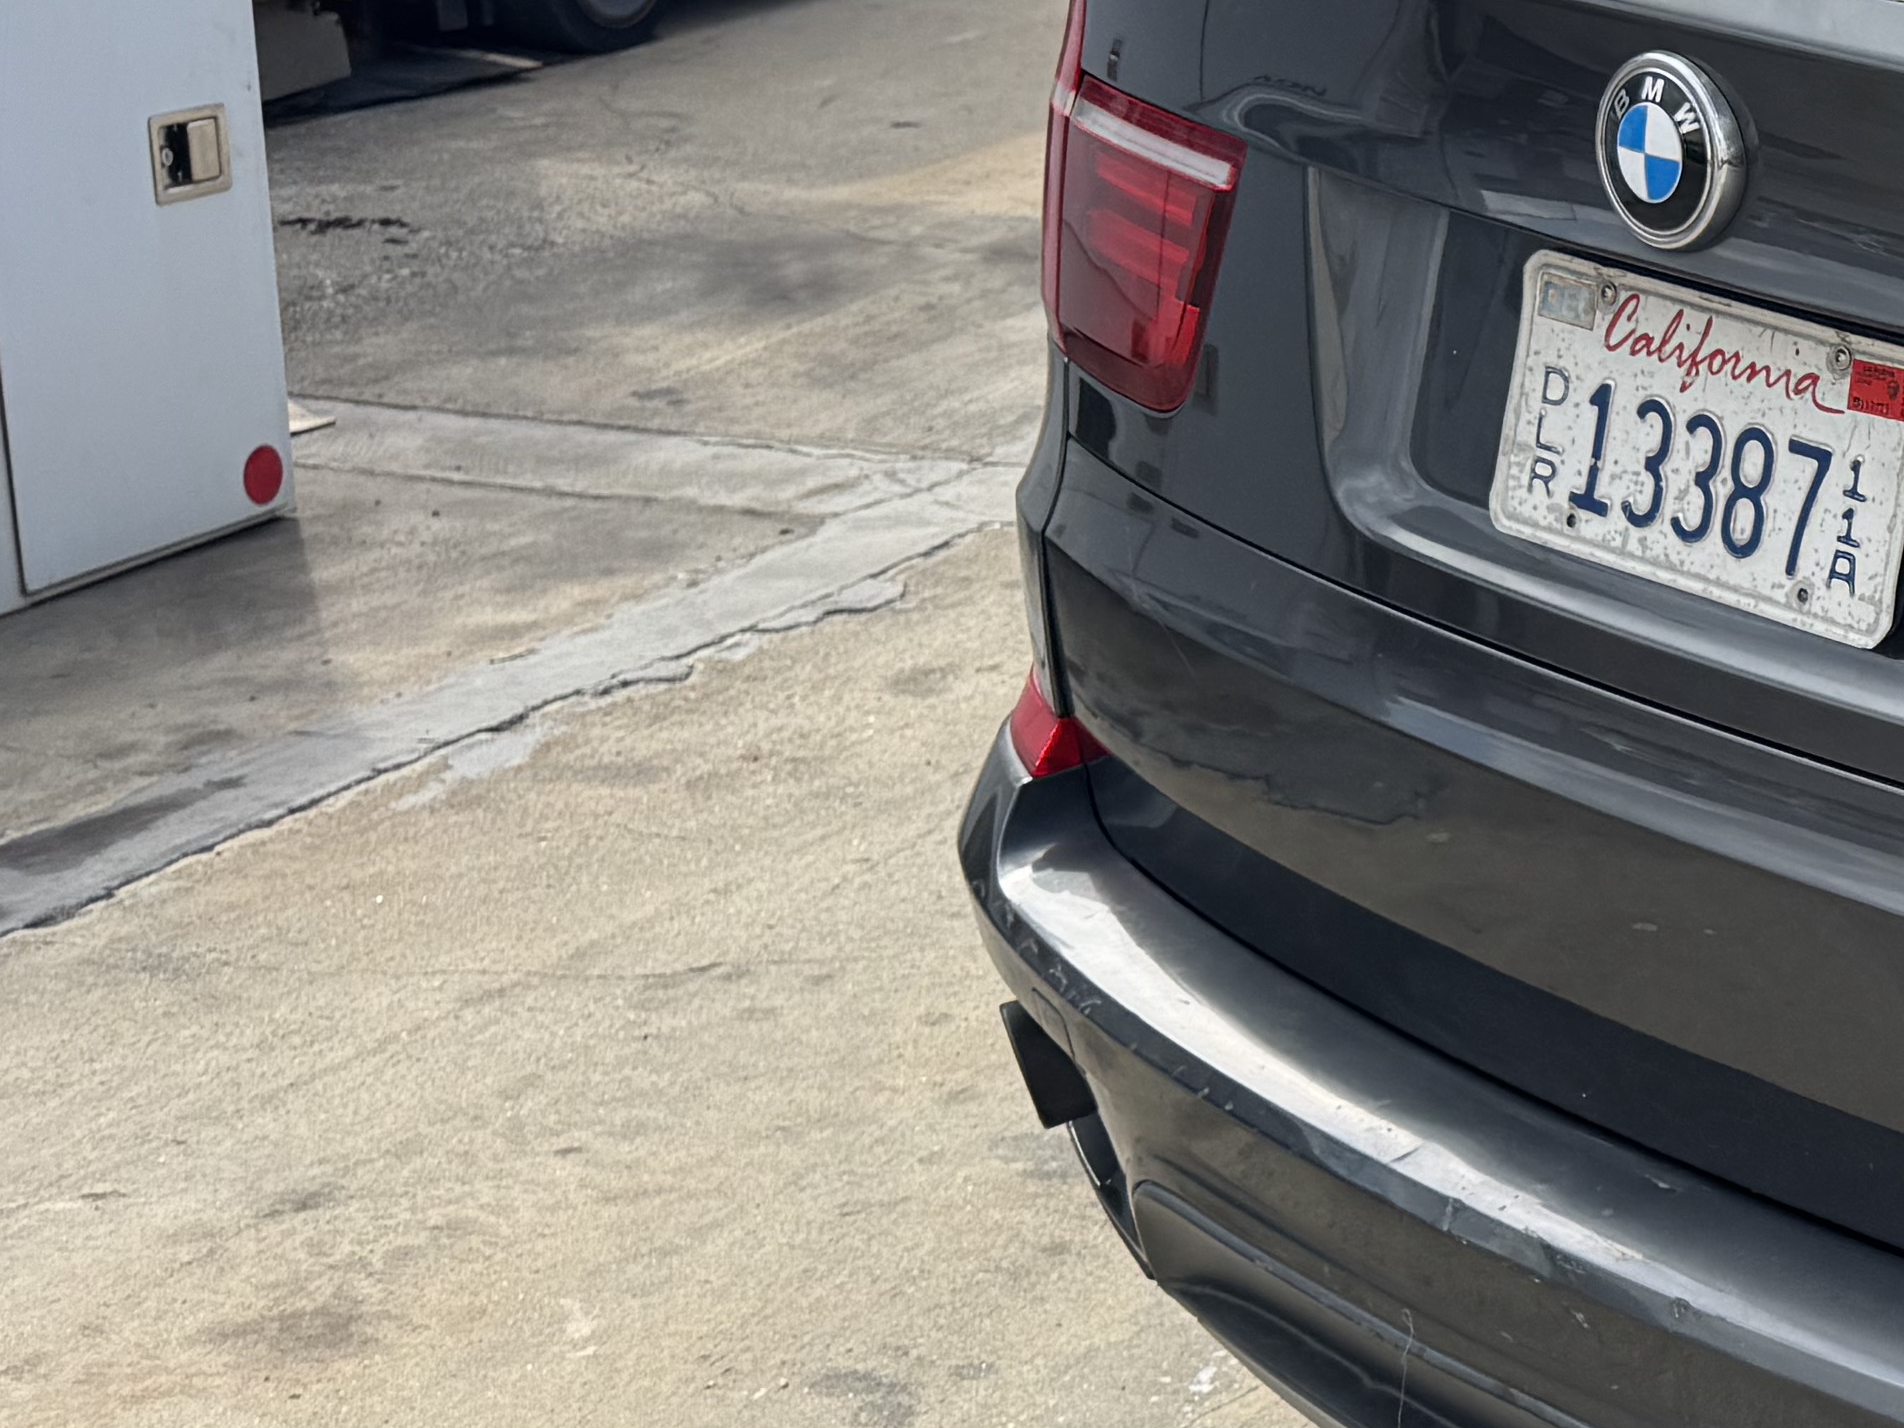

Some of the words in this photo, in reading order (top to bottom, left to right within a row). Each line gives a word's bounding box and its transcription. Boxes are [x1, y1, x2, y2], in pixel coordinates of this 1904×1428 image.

[1614, 75, 1700, 134] BMW
[1603, 292, 1846, 415] California
[1568, 378, 1833, 578] 13387
